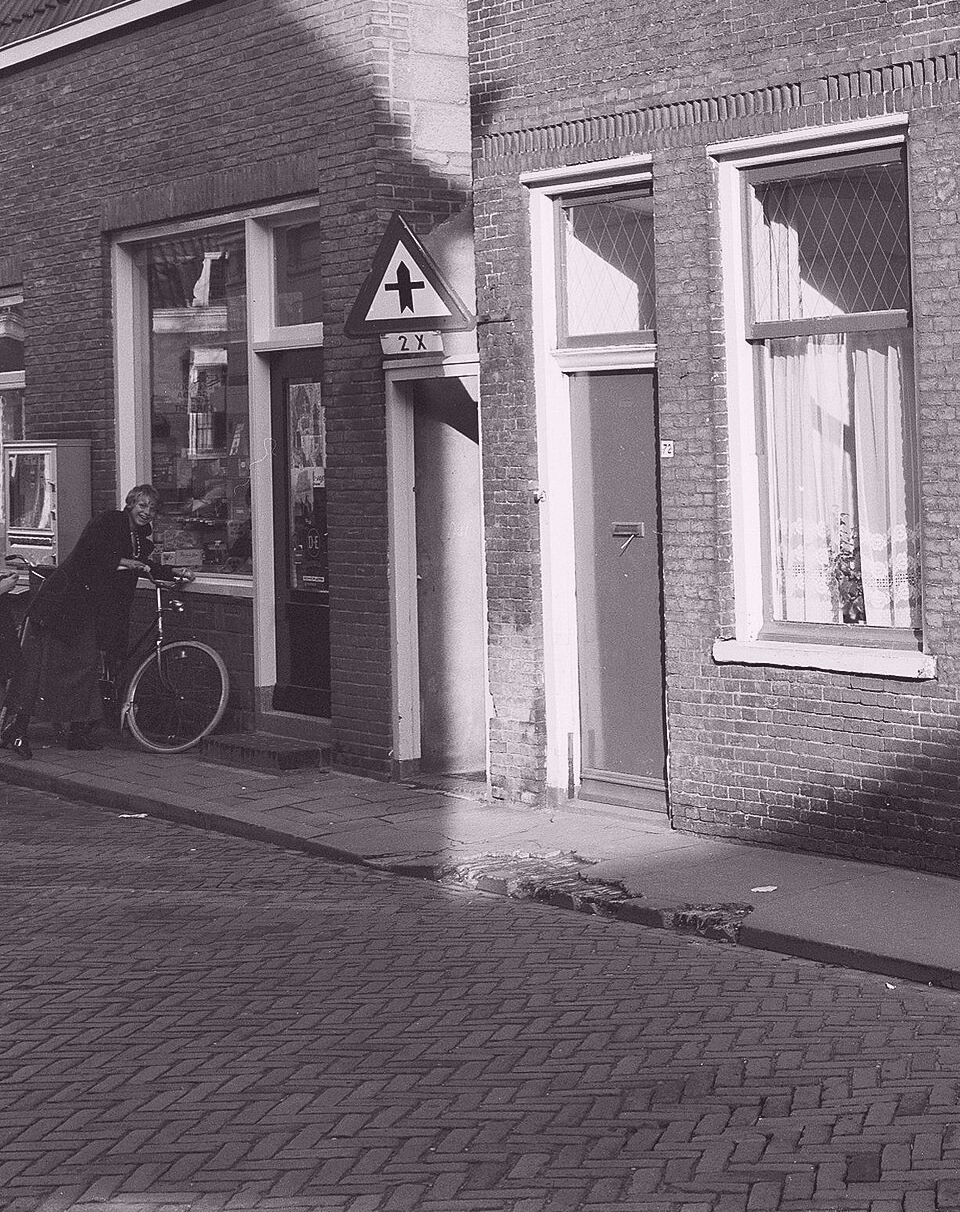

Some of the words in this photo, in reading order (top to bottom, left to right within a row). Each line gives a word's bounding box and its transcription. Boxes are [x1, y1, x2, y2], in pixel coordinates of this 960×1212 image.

[398, 335, 410, 351] 2
[414, 334, 427, 350] X
[663, 443, 672, 454] 72
